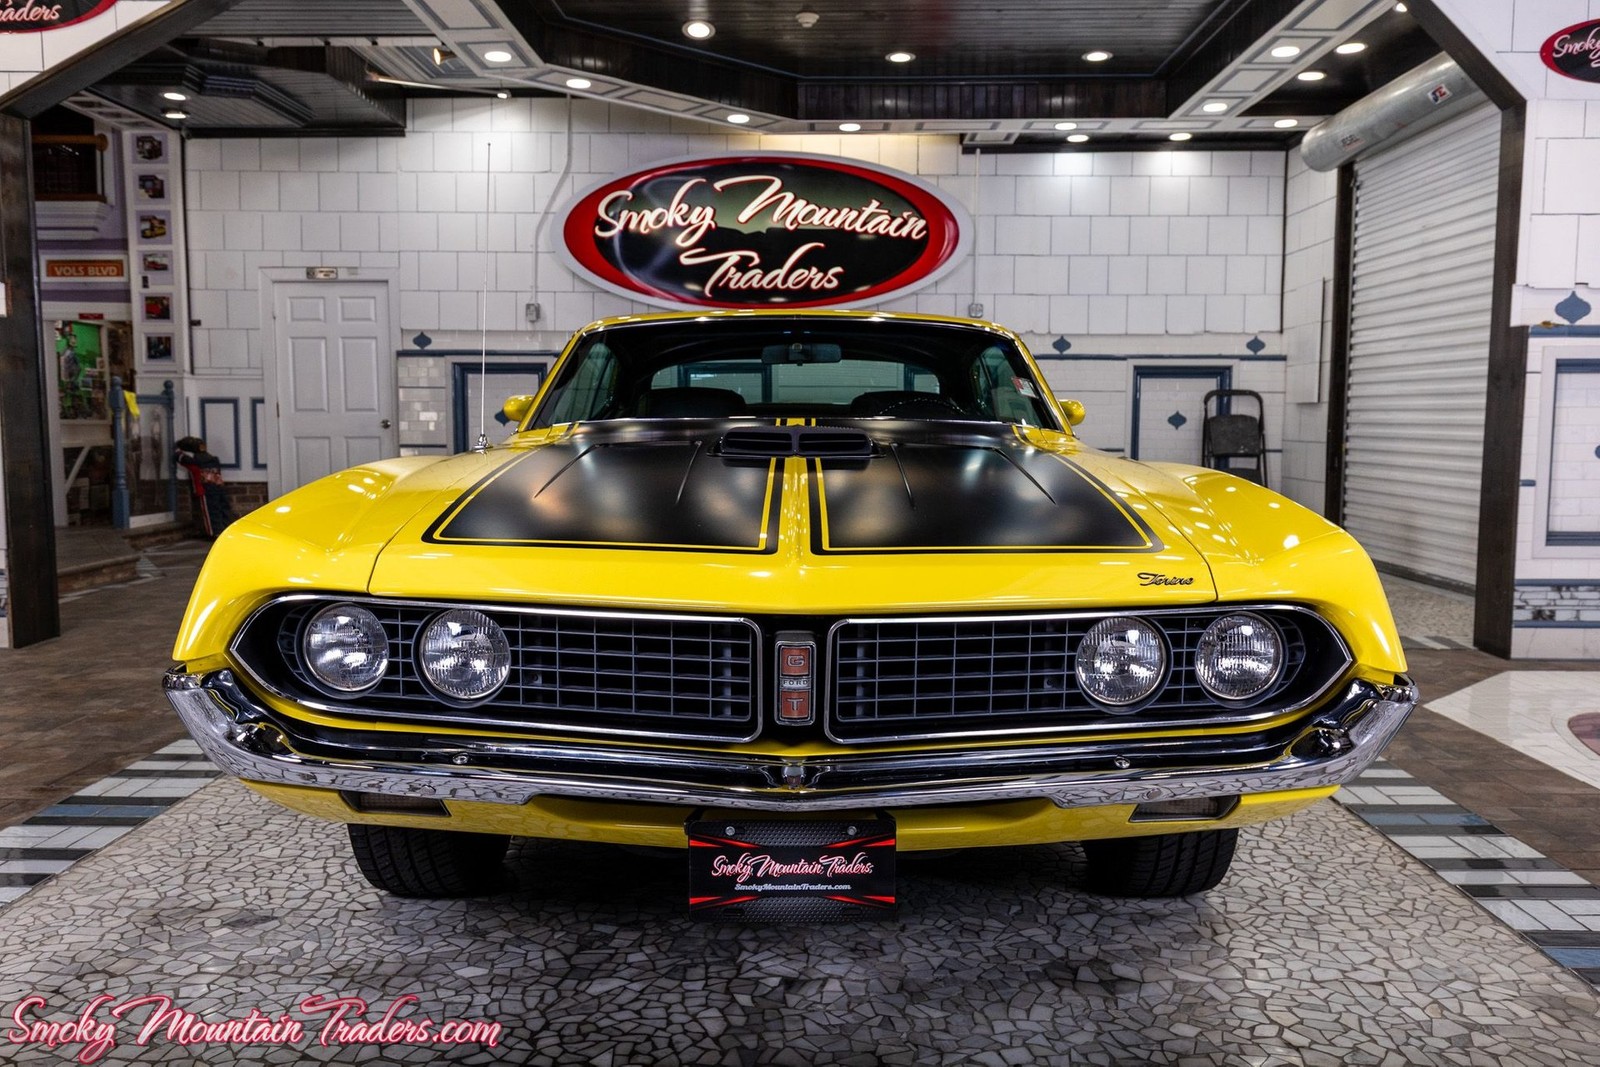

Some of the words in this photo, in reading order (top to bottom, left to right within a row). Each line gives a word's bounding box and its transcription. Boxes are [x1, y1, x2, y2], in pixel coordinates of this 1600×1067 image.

[0, 0, 62, 21] aders
[594, 178, 716, 248] Smoky
[713, 175, 928, 241] Mountain
[54, 266, 85, 276] VOLS
[87, 266, 118, 276] BLVD
[679, 242, 844, 298] Traders
[1137, 572, 1194, 586] Torino
[787, 655, 805, 667] G
[786, 698, 804, 711] T
[711, 852, 754, 882] Smoky
[747, 854, 824, 877] Mountain
[819, 852, 874, 877] Traders
[734, 883, 851, 892] SmokyMountainTraders.com
